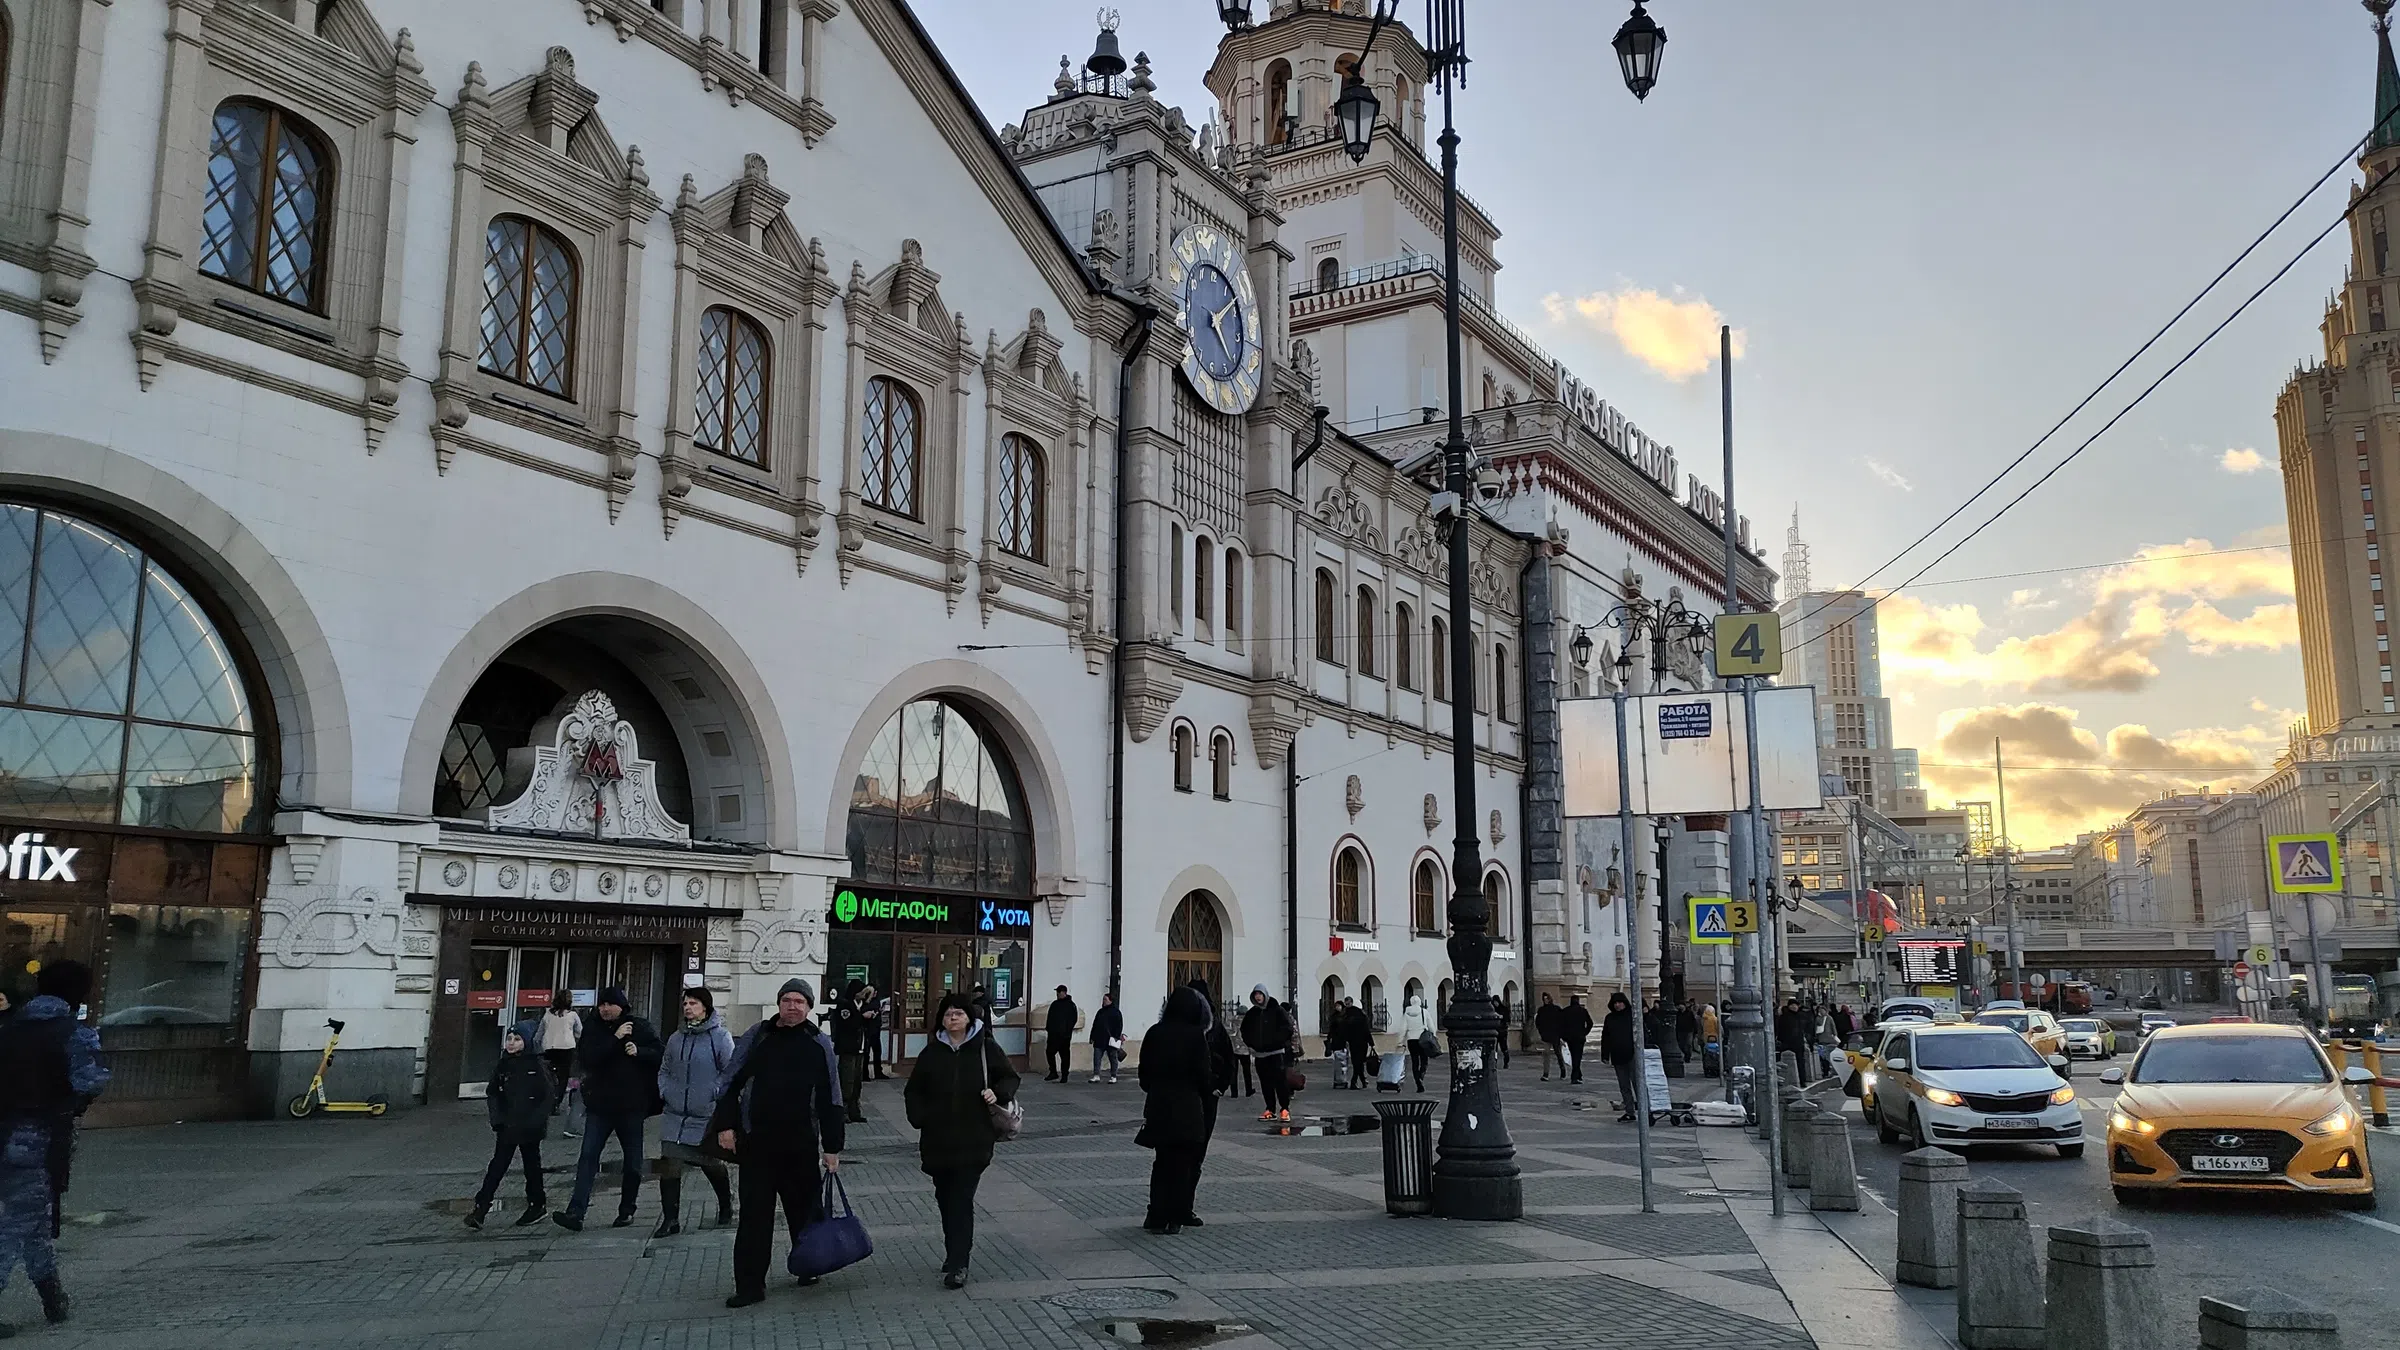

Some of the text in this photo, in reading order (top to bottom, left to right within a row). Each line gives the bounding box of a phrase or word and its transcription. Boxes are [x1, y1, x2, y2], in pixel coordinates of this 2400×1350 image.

[1553, 358, 1752, 550] КАЗАНСКИЙ ВОКАЛ
[1730, 623, 1765, 665] 4
[1660, 705, 1708, 716] РАБОТА
[0, 832, 80, 882] fix
[448, 908, 592, 925] МЕТРОПОЛИТЕН
[997, 908, 1031, 927] YOTA
[1733, 907, 1749, 928] 3
[492, 925, 671, 939] СТАНЦИЯ КОМСОМОЛЬСКАЯ
[1870, 927, 1878, 939] 2
[692, 941, 699, 952] 3
[1977, 943, 1982, 953] 1
[2256, 949, 2267, 962] 6
